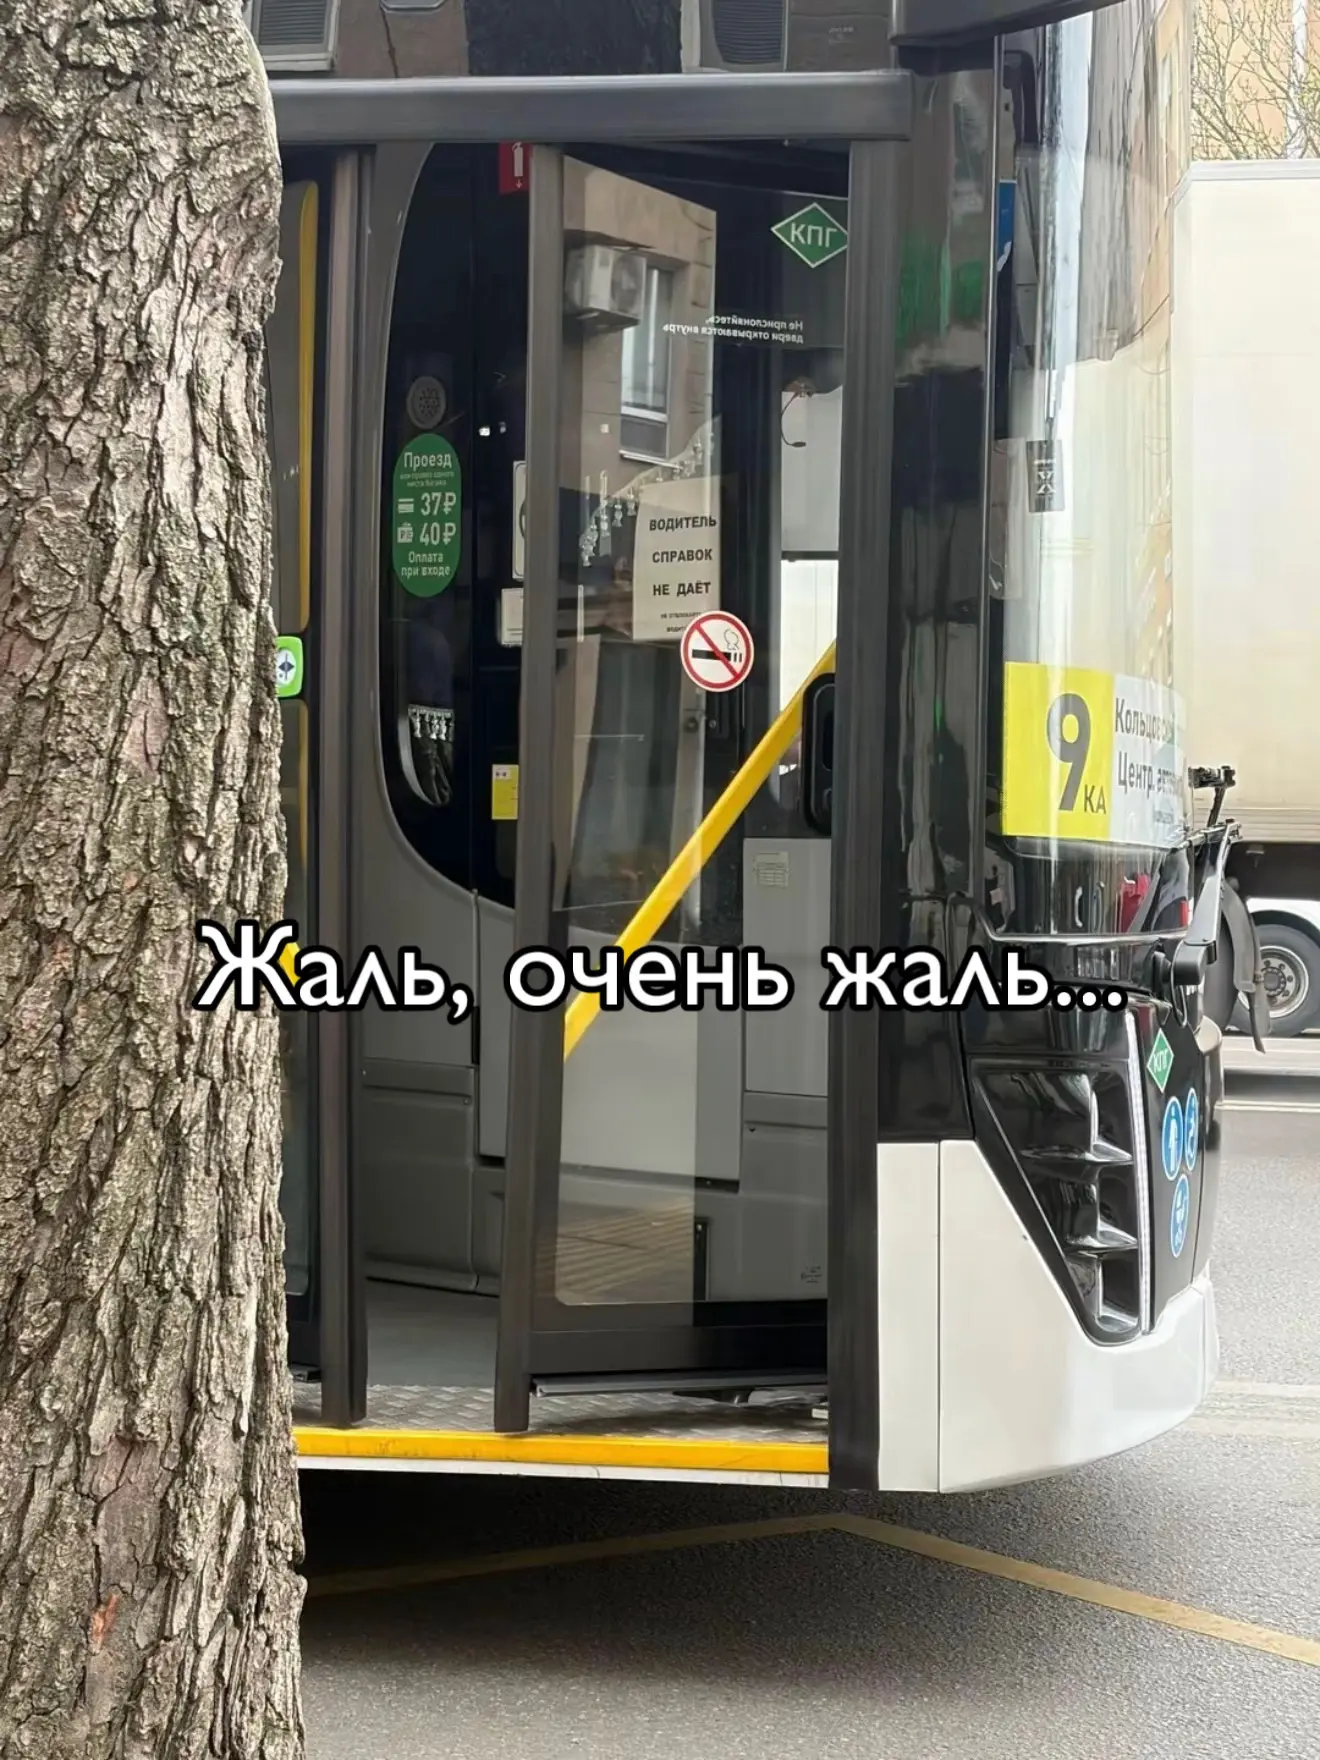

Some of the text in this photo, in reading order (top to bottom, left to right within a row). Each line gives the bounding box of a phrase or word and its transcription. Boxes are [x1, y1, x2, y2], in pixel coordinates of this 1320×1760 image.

[790, 222, 838, 248] КПГ
[403, 451, 453, 472] Проезд
[649, 515, 718, 532] ВОДИТЕЛЬ
[408, 551, 444, 563] Оплата
[652, 548, 713, 564] СПРАВОК
[401, 566, 451, 580] при входе
[653, 580, 712, 597] НЕ ДАЁТ
